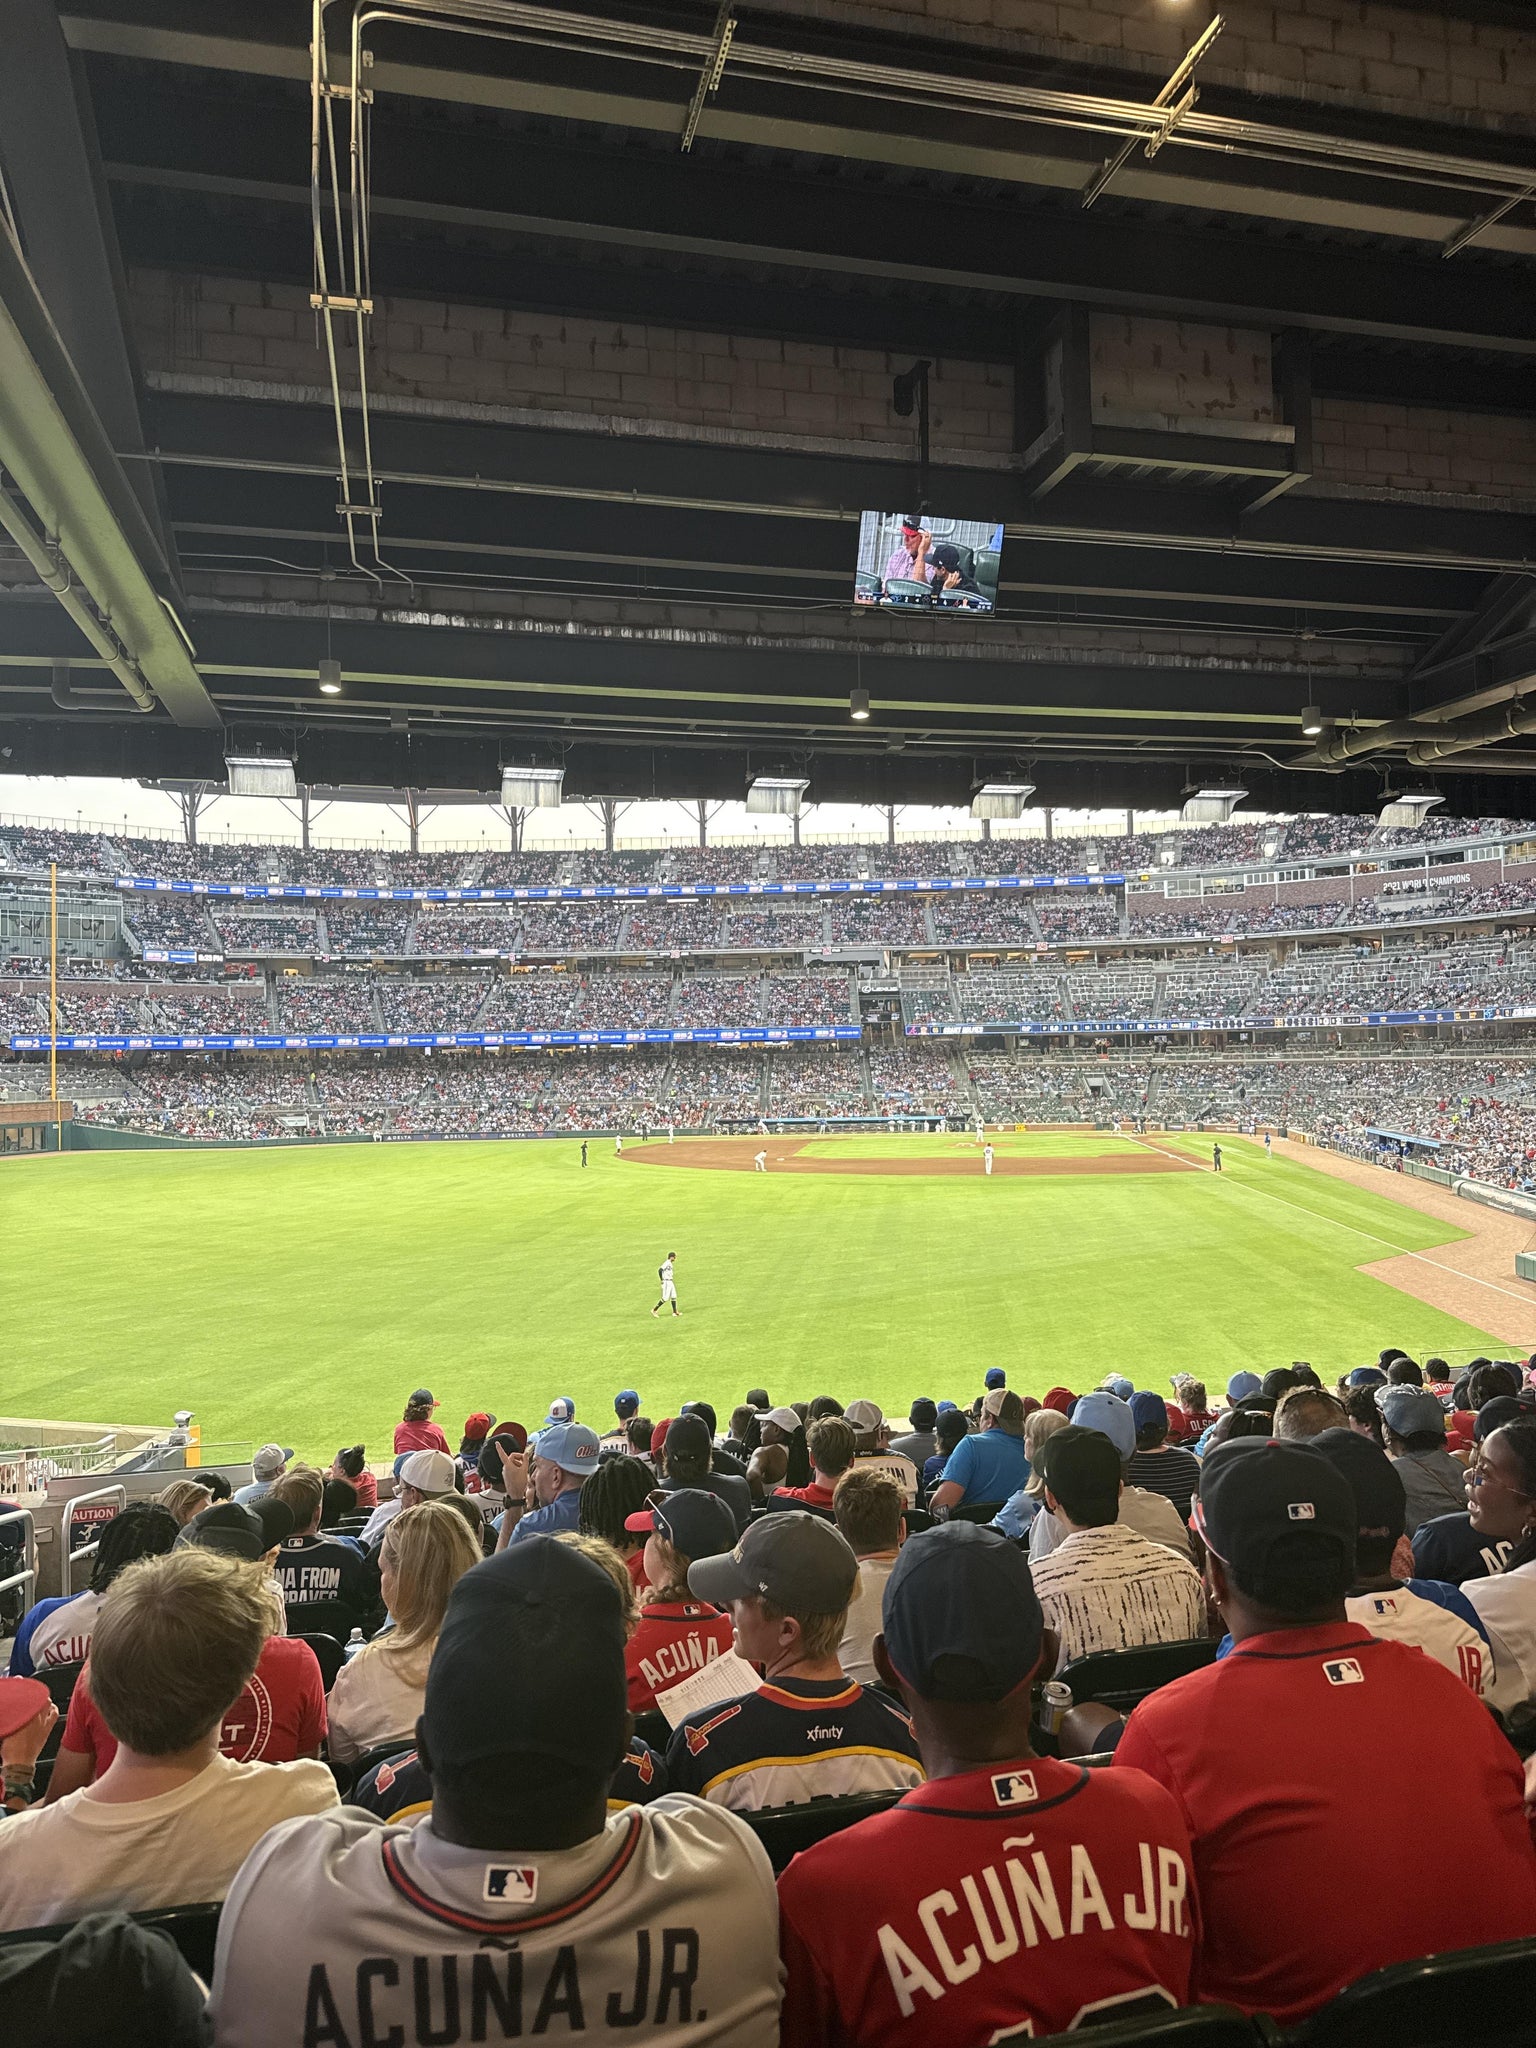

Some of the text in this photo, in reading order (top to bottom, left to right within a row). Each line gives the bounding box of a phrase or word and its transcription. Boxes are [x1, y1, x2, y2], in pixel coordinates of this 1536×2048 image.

[1429, 873, 1471, 887] CHAMPIONS
[72, 1508, 115, 1520] AUTION
[300, 1567, 341, 1589] FROM
[638, 1631, 720, 1690] ACUÑA
[806, 1725, 843, 1741] xfinity
[877, 1832, 1115, 2018] ACUÑA
[1123, 1842, 1189, 1938] JR.
[303, 1927, 708, 2048] ACUÑA JR.
